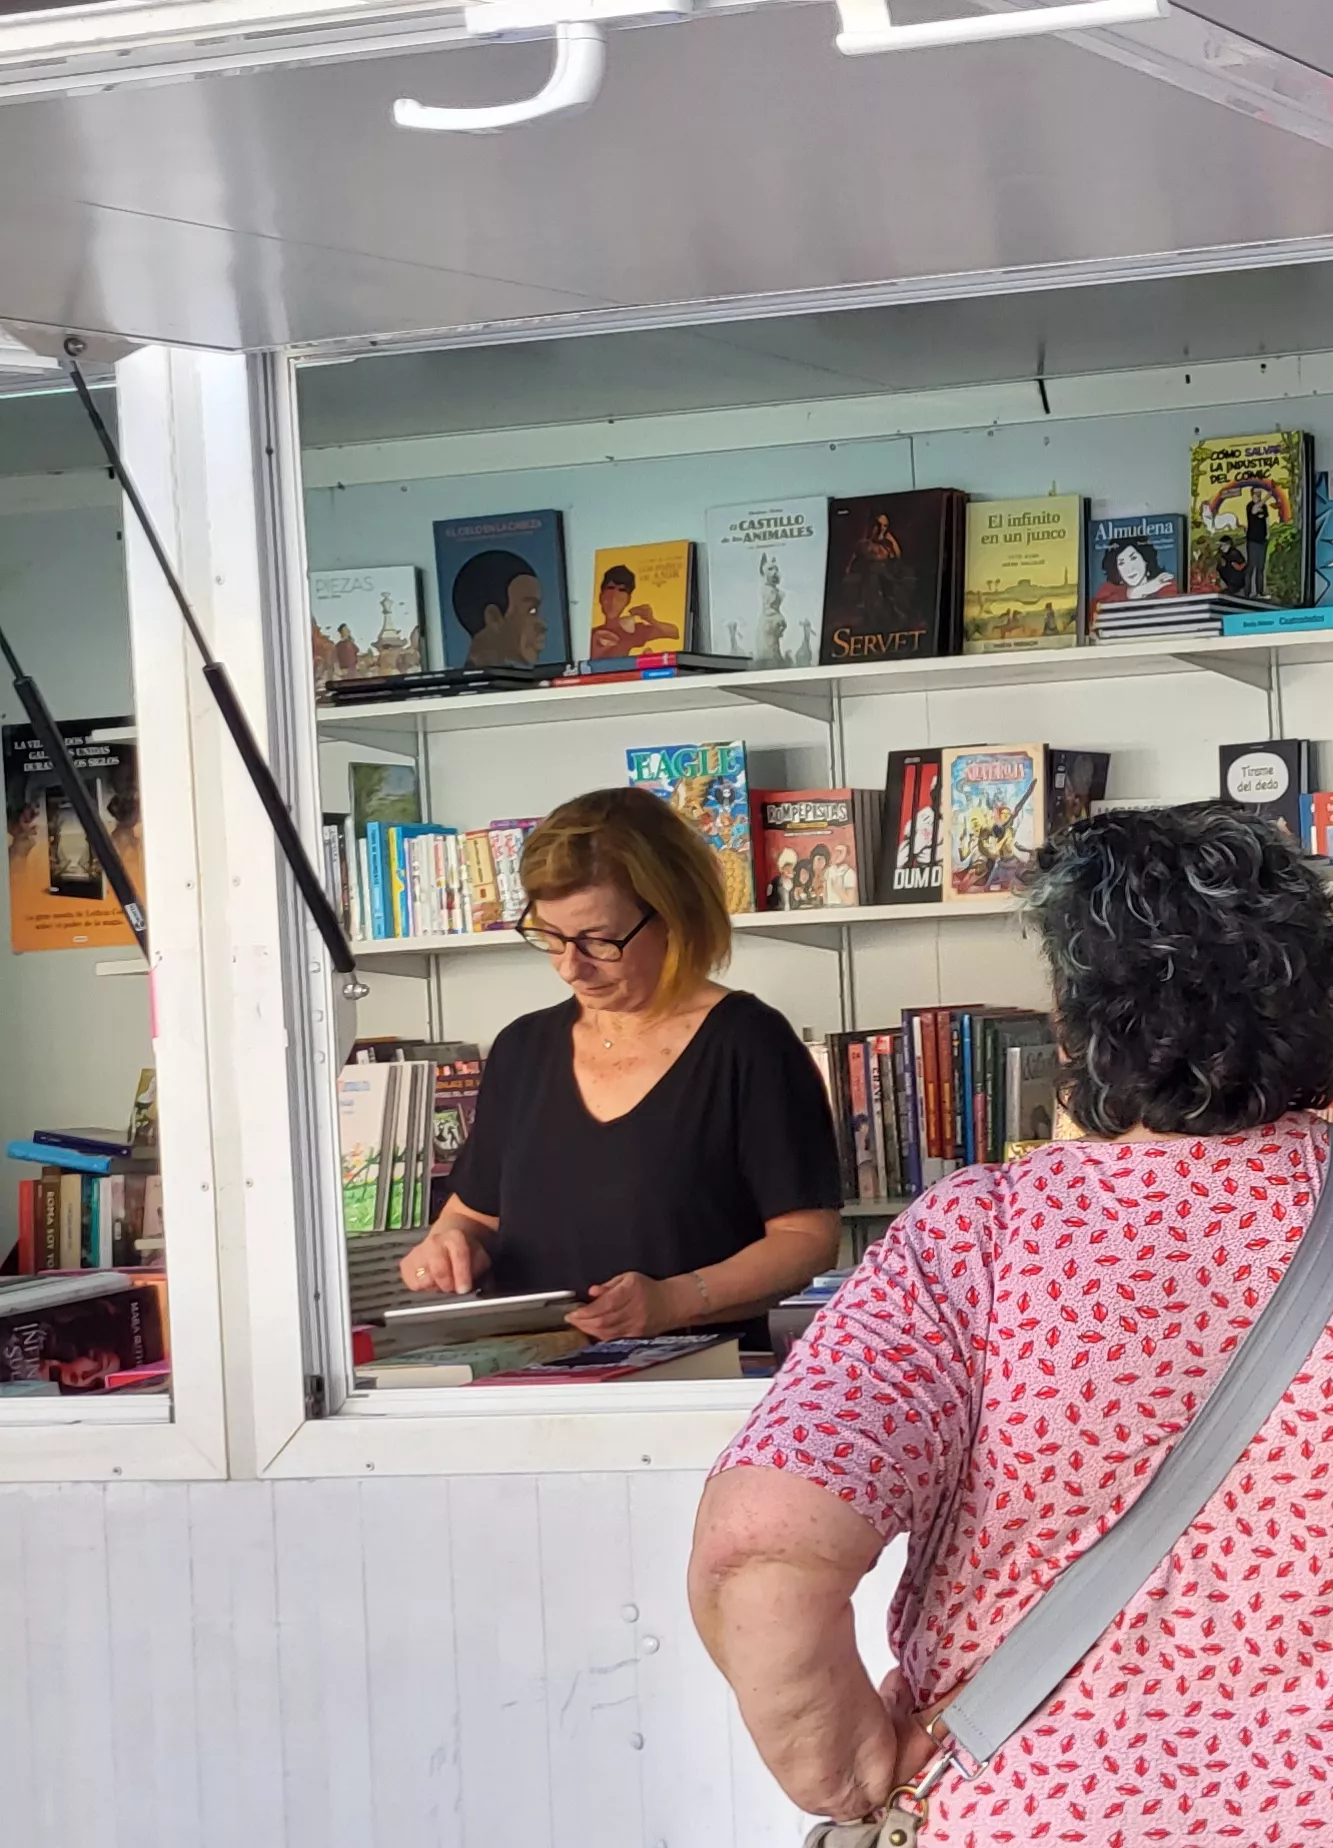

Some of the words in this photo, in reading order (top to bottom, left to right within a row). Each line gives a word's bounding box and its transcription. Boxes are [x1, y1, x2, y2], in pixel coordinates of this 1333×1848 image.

[1209, 462, 1224, 472] LA
[1226, 456, 1280, 473] INDUSTRIA
[1209, 473, 1231, 484] DEL
[738, 514, 804, 531] CASTILLO
[988, 513, 1003, 528] El
[1007, 511, 1061, 528] infinito
[742, 525, 814, 543] ANIMALES
[981, 533, 999, 545] en
[1003, 532, 1022, 544] un
[1026, 528, 1067, 546] junco
[1094, 518, 1174, 541] Almudena
[315, 576, 375, 594] PIEZAS
[830, 627, 927, 659] SERVET
[631, 745, 739, 783] EAGLE
[46, 1191, 56, 1226] ROMA
